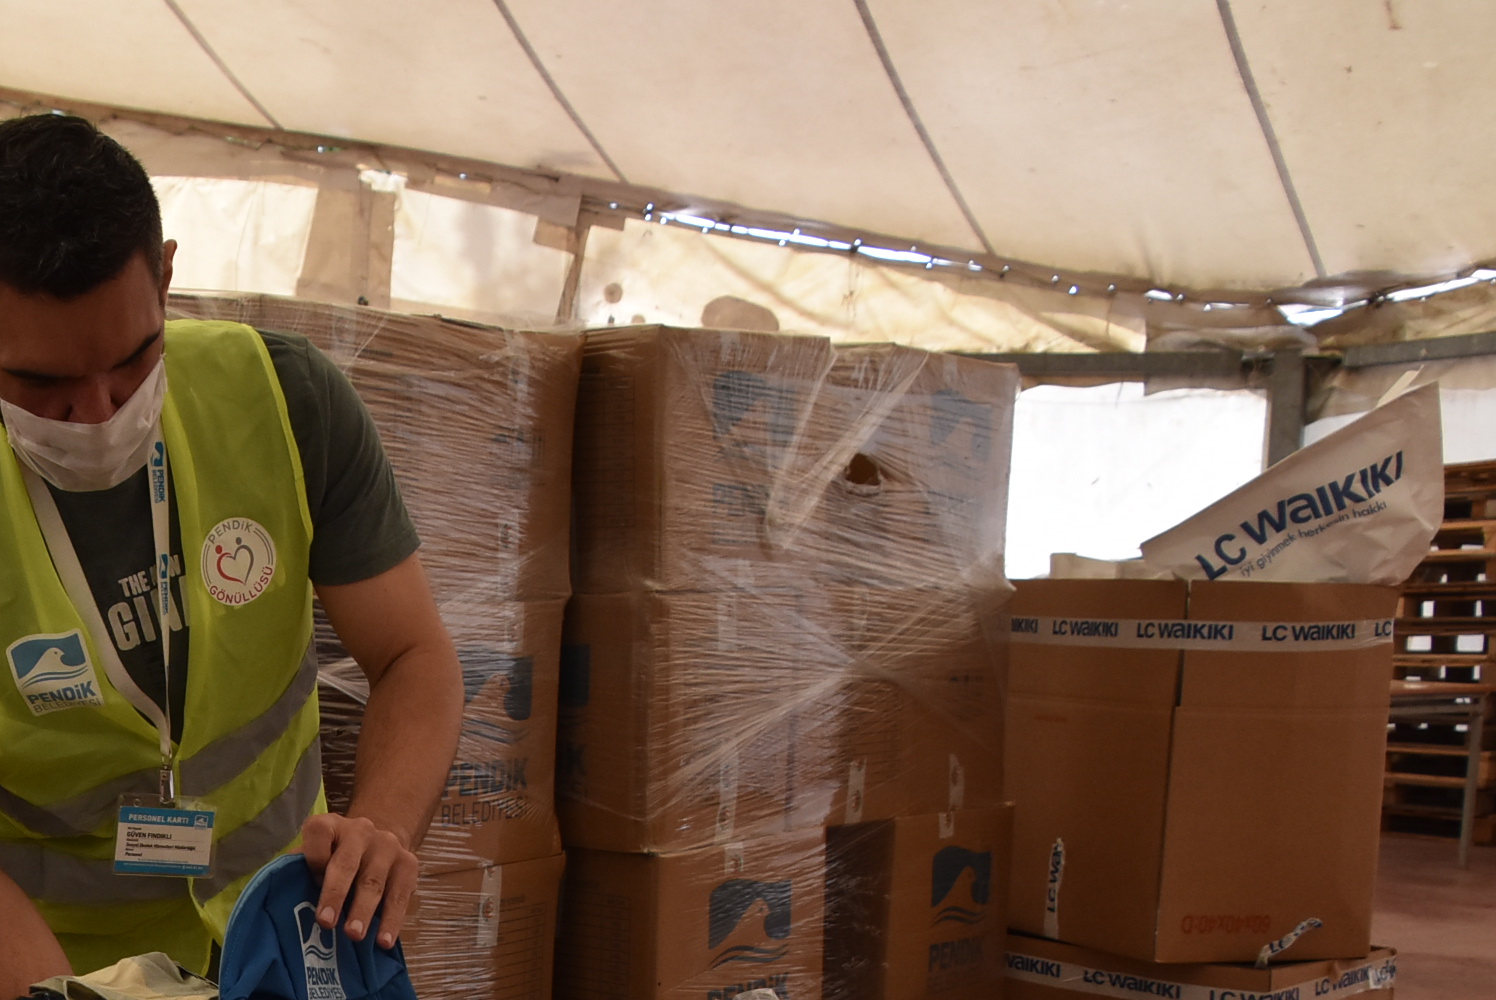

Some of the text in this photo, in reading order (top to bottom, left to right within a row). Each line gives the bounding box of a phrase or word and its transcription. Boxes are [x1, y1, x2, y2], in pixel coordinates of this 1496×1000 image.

[1195, 533, 1247, 580] LC
[118, 570, 151, 597] THE
[209, 566, 273, 604] GÖNÜLLÜSÜ
[1052, 619, 1067, 635] LC
[1136, 622, 1155, 638] LC
[1261, 625, 1288, 641] LC
[1374, 620, 1392, 637] LC
[128, 813, 189, 824] PERSONEL KARTI
[126, 830, 147, 839] GÜVEN
[1083, 970, 1105, 985] LC
[1315, 978, 1330, 997] LC
